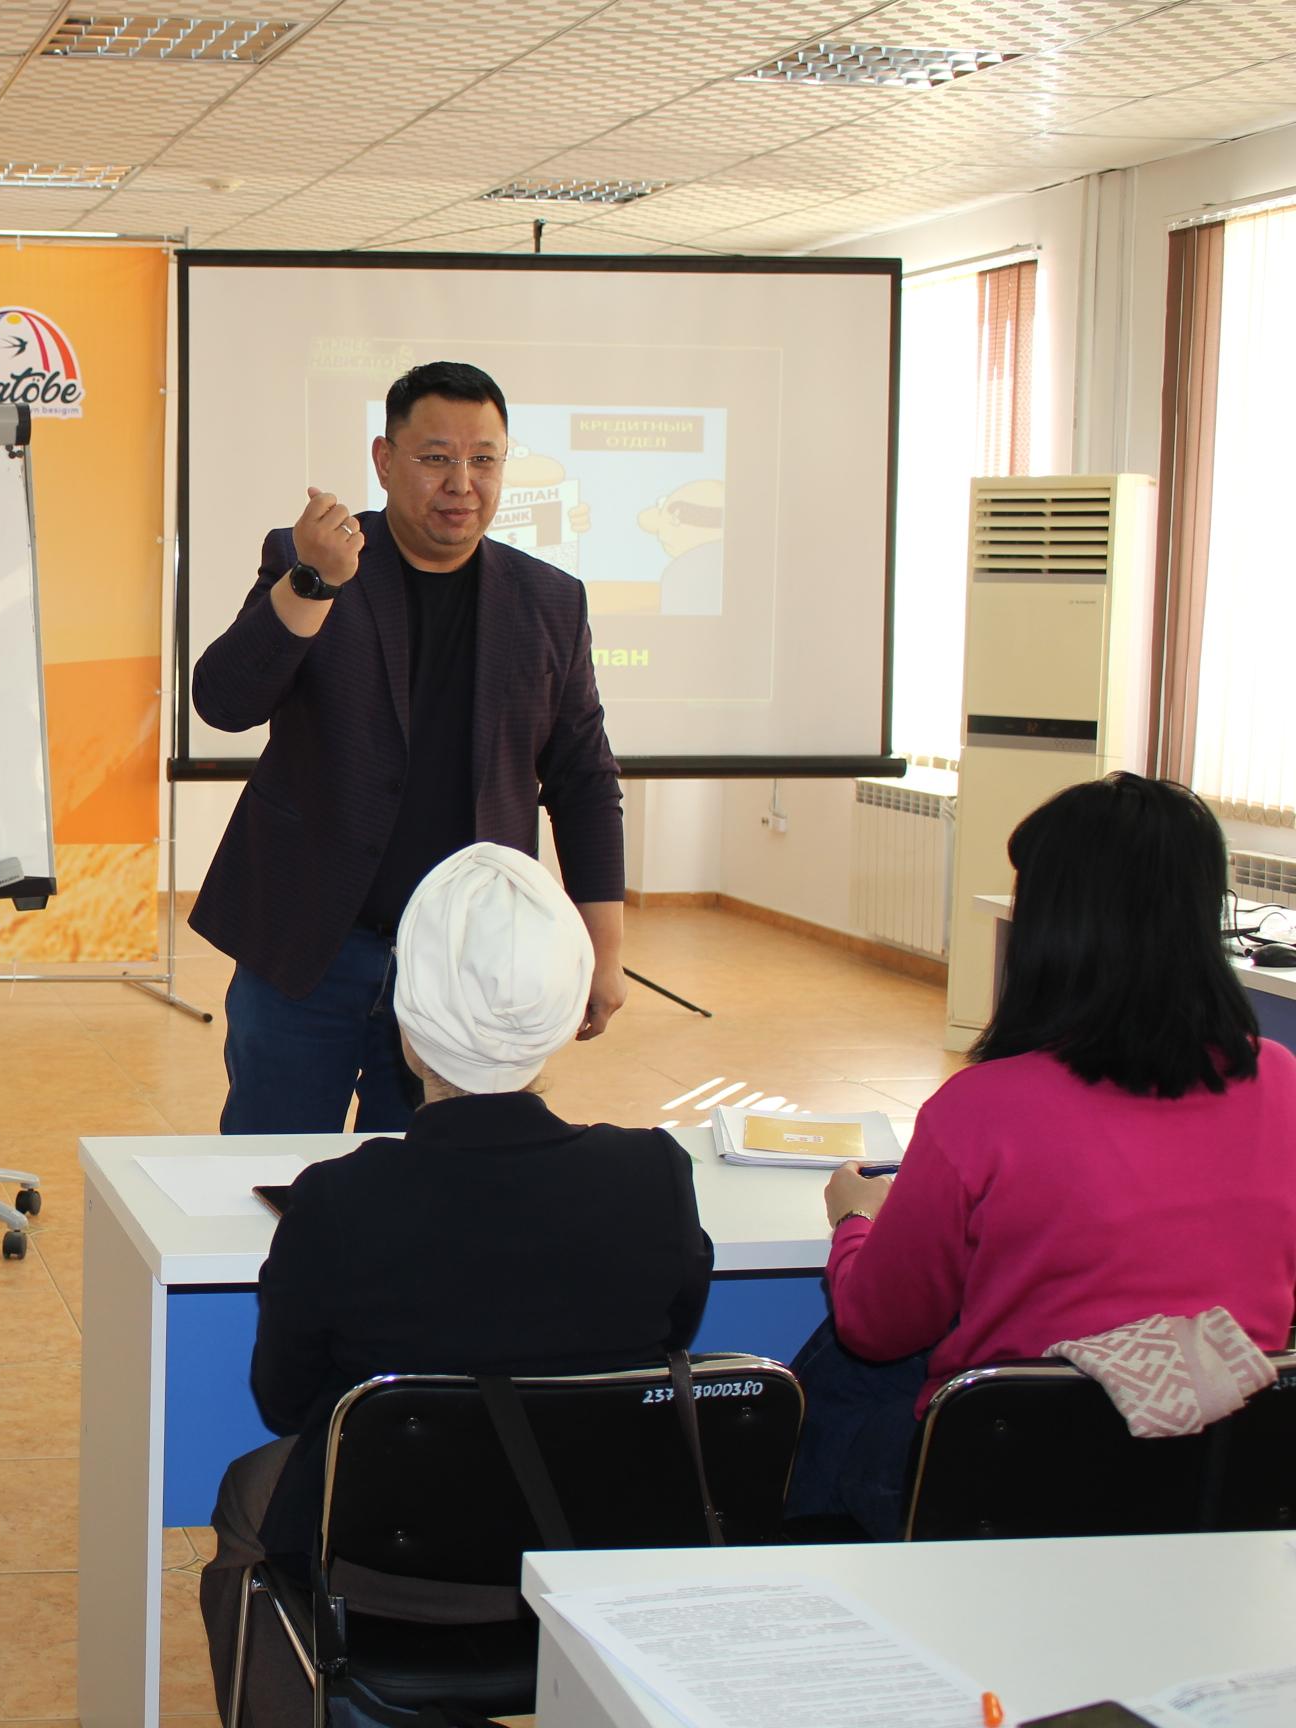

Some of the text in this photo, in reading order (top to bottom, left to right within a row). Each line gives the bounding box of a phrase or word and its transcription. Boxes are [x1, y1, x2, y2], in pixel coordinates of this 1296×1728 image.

[579, 418, 693, 433] КРЕДИТНЫЙ
[606, 435, 667, 449] ОТДЕЛ
[643, 1380, 764, 1403] 2373000380
